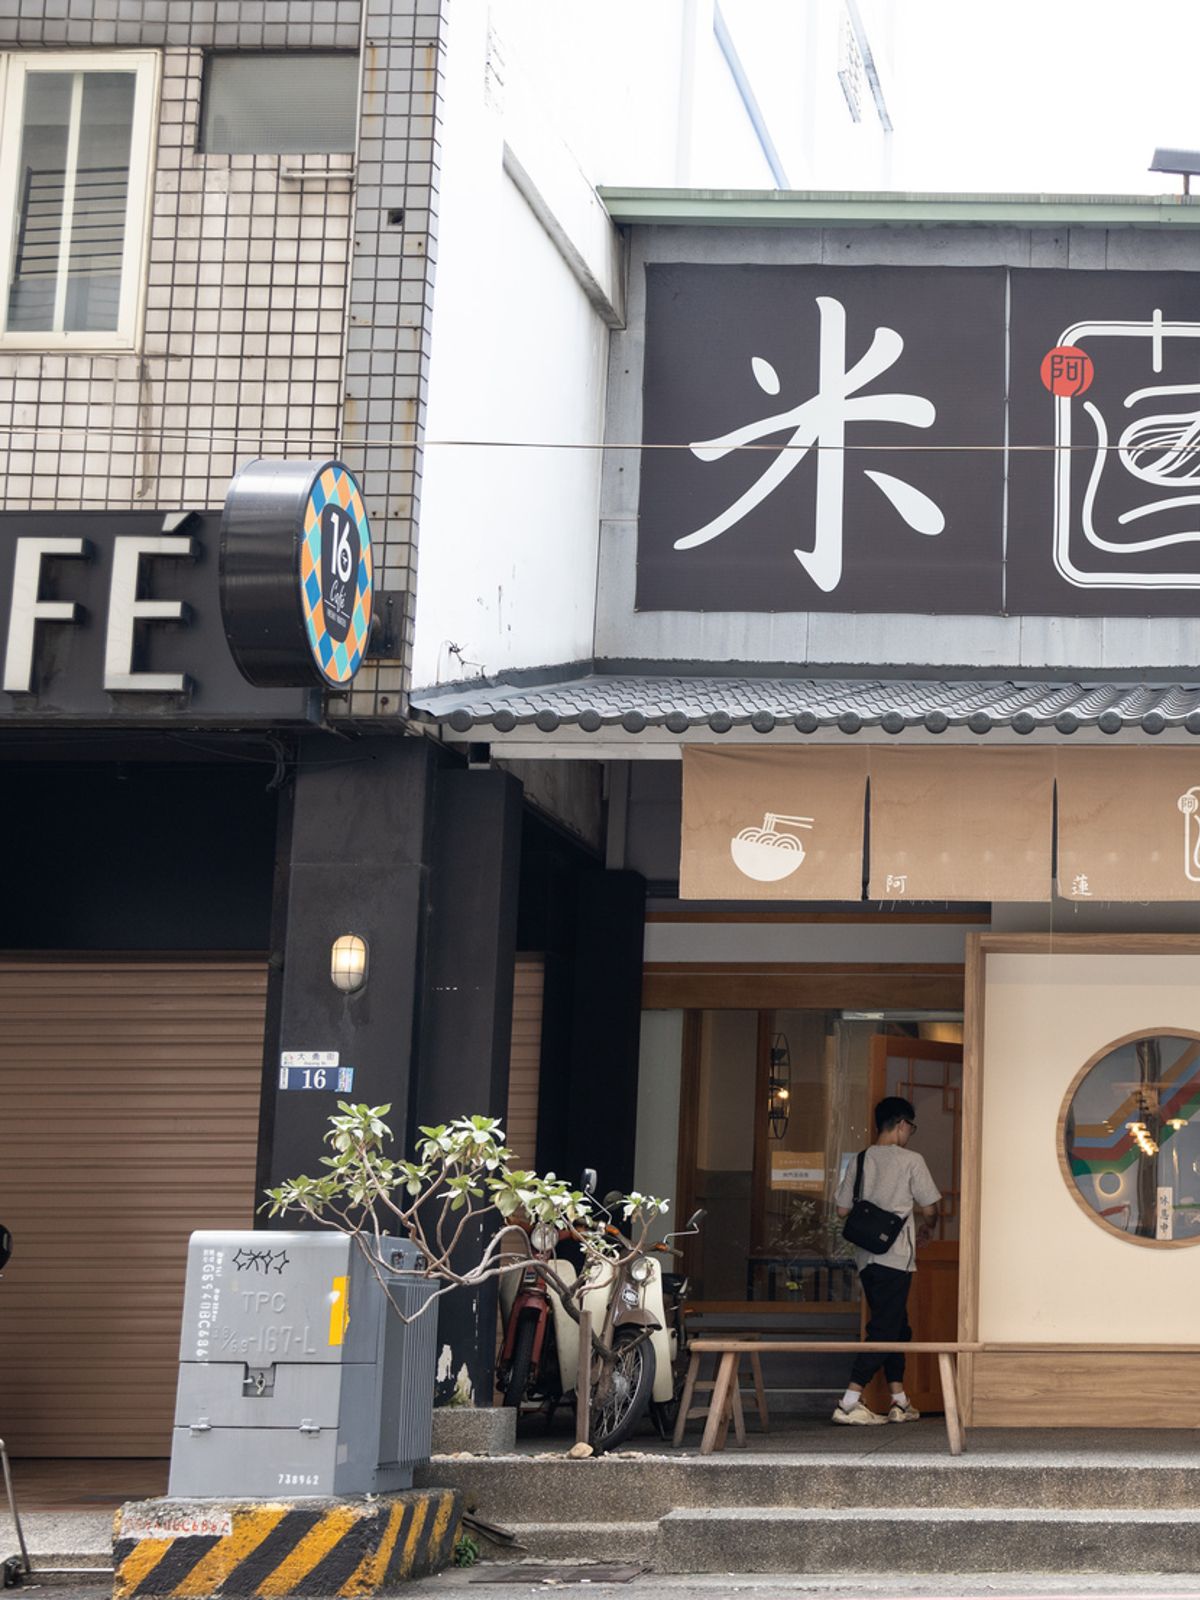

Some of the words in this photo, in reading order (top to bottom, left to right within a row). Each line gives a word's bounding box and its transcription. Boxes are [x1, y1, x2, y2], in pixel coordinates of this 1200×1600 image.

[673, 296, 946, 592] 米
[1049, 354, 1089, 397] 阿
[331, 512, 352, 582] 16
[3, 511, 196, 692] FÉ
[886, 875, 908, 894] 阿
[1072, 874, 1093, 896] 蓮
[302, 1069, 326, 1089] 16
